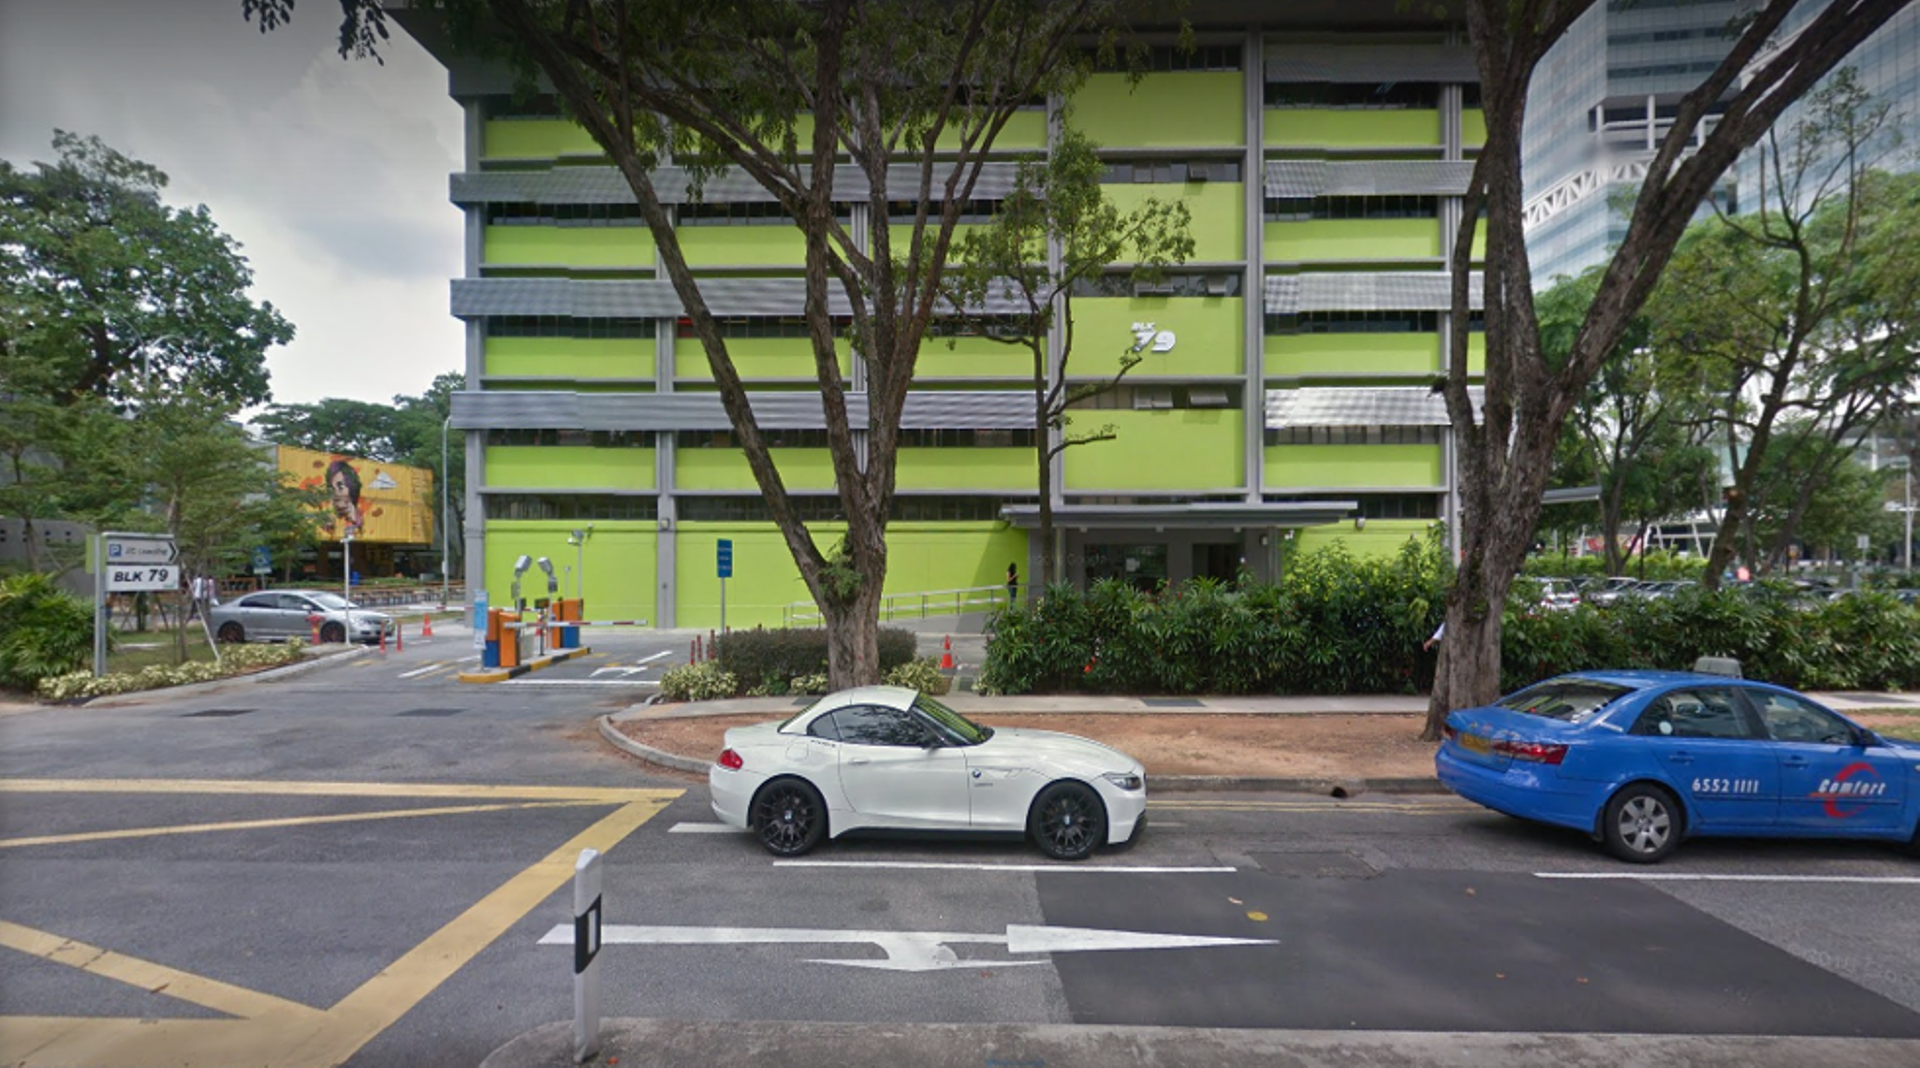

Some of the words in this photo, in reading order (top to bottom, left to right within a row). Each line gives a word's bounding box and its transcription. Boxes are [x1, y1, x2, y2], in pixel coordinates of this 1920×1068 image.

[1132, 330, 1176, 353] 79
[113, 571, 143, 582] BLK
[148, 569, 169, 582] 79
[1692, 778, 1730, 792] 6552
[1733, 779, 1759, 793] 1111
[1818, 779, 1886, 796] Comfort
